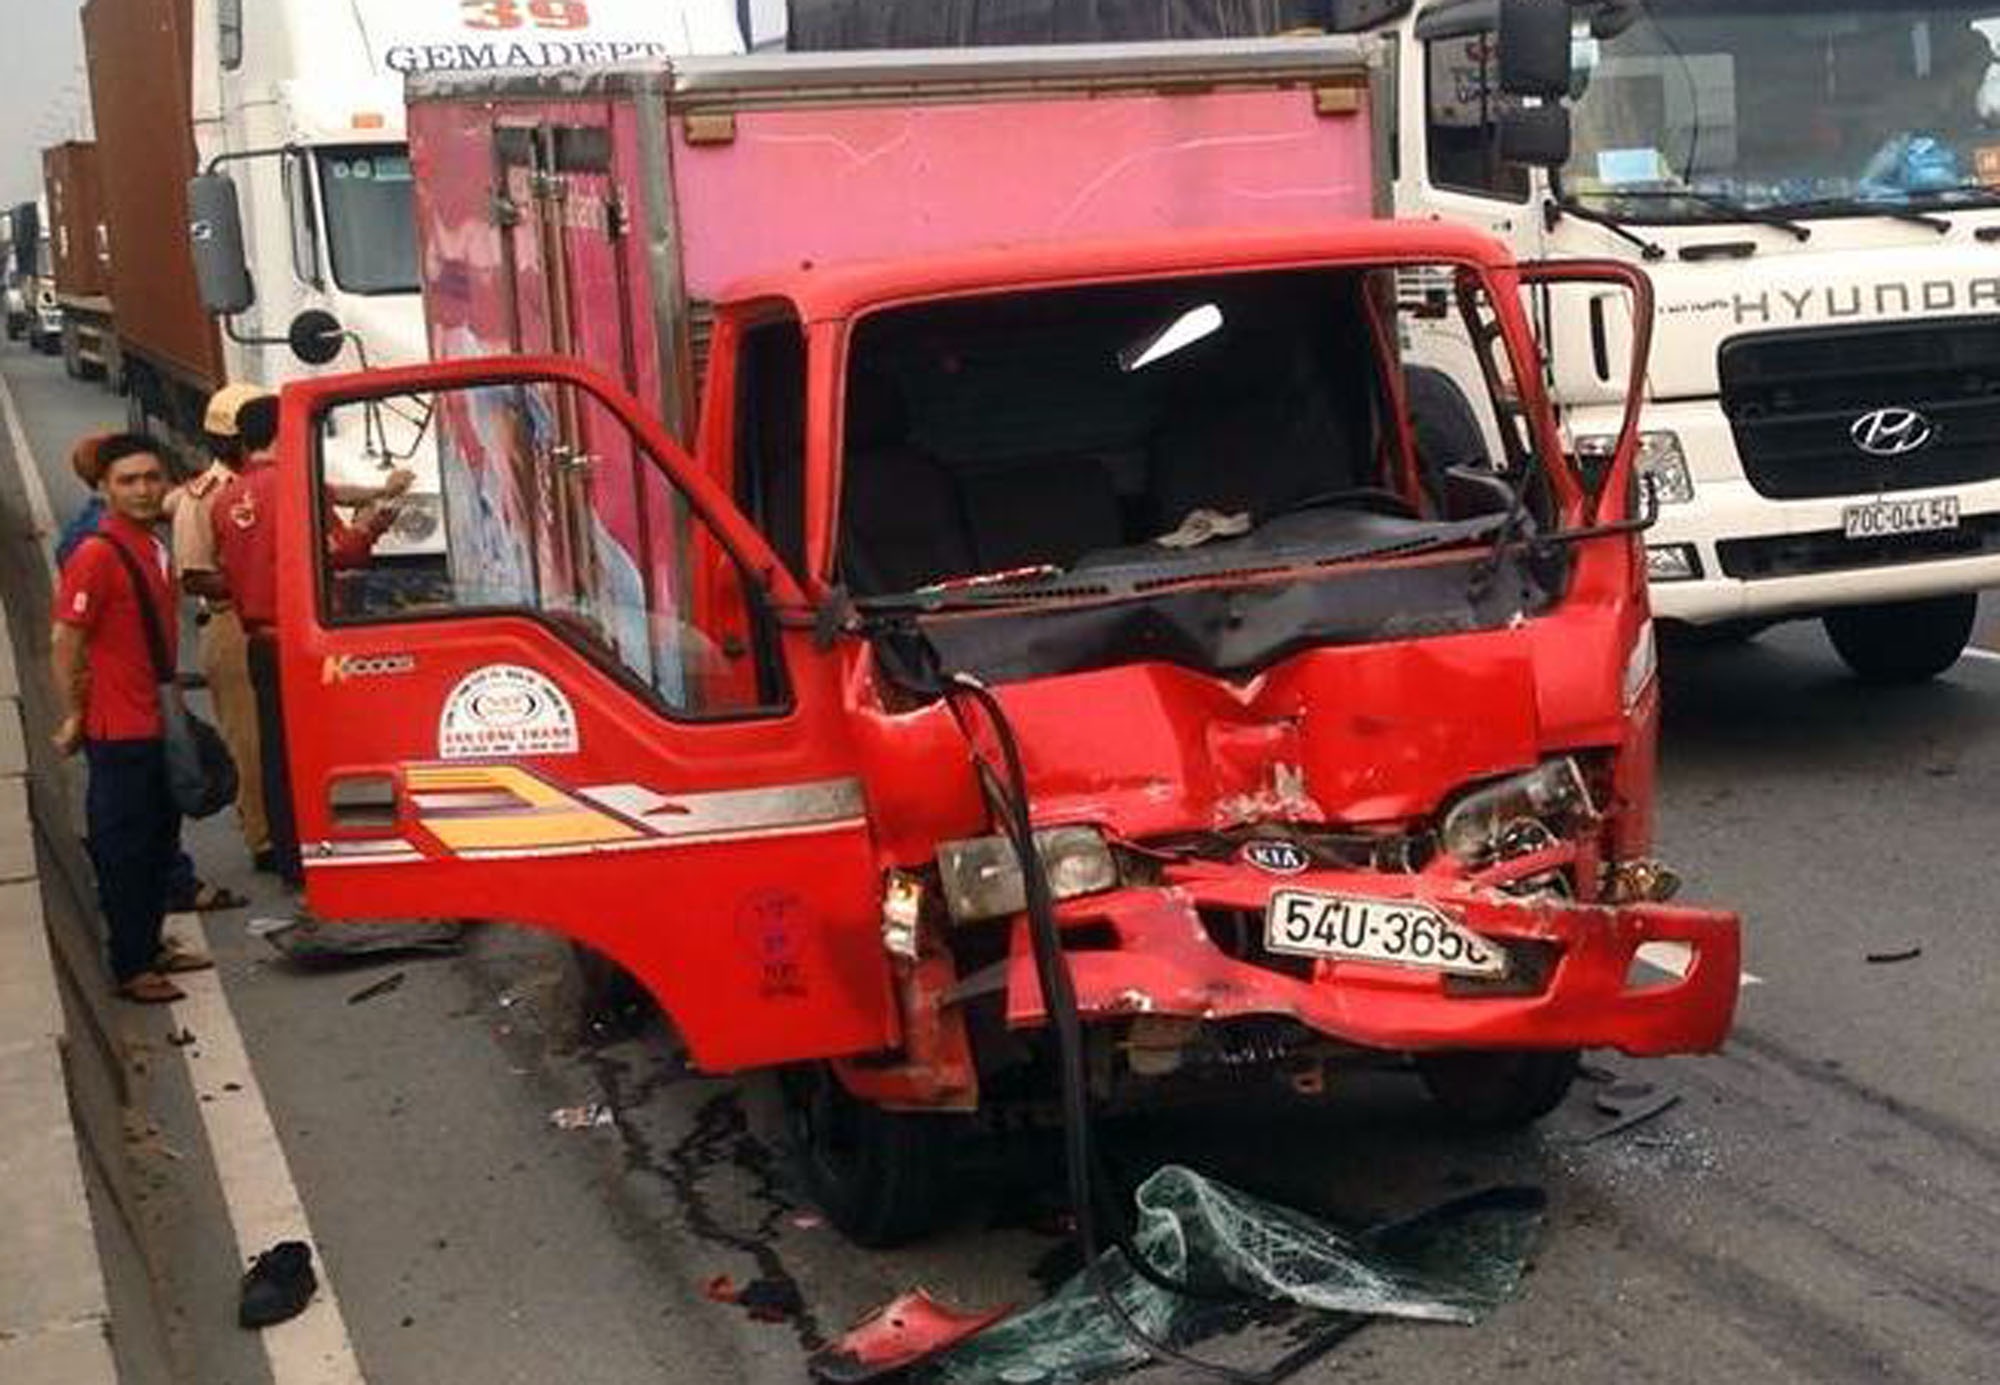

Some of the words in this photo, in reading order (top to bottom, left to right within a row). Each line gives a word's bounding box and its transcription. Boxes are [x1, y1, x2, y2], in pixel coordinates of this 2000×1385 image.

[460, 0, 590, 30] 39
[384, 42, 665, 74] GEMADEPT
[1254, 848, 1298, 867] KIA
